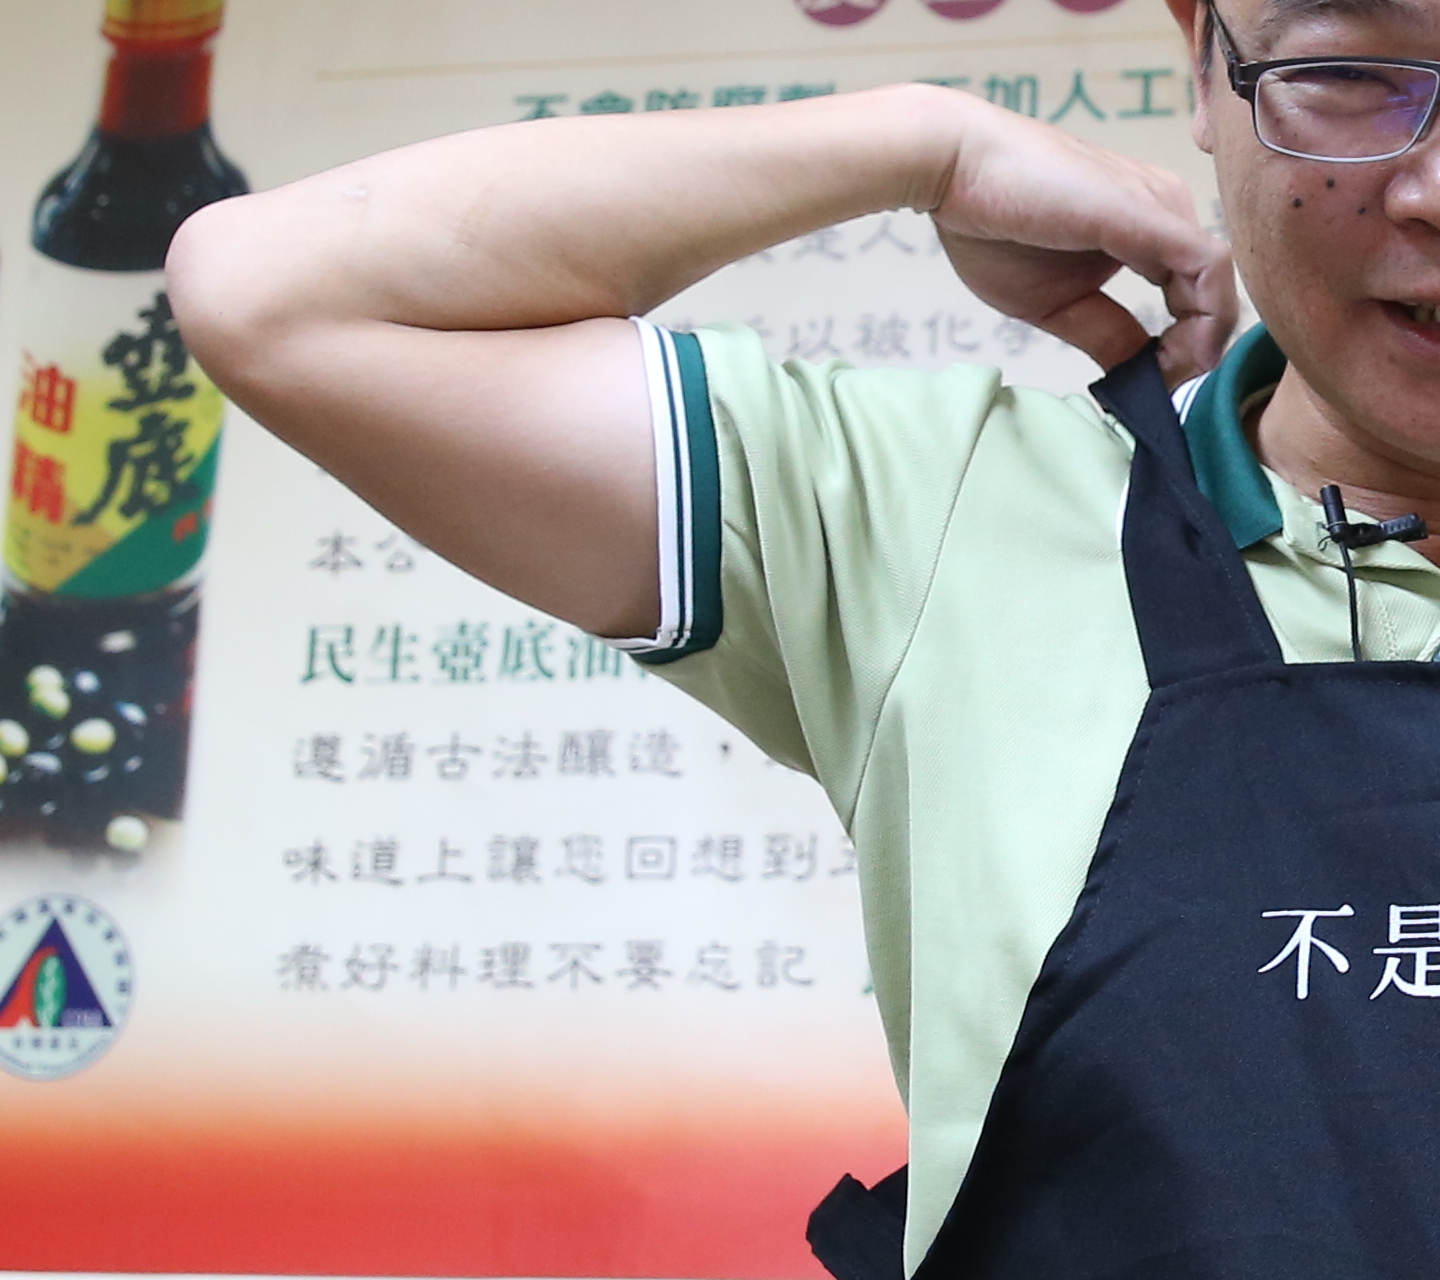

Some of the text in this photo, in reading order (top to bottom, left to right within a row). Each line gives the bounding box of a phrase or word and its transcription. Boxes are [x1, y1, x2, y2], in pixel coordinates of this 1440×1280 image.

[300, 616, 656, 686] 民生壺底油
[275, 938, 818, 993] 煮好料理不要忘記
